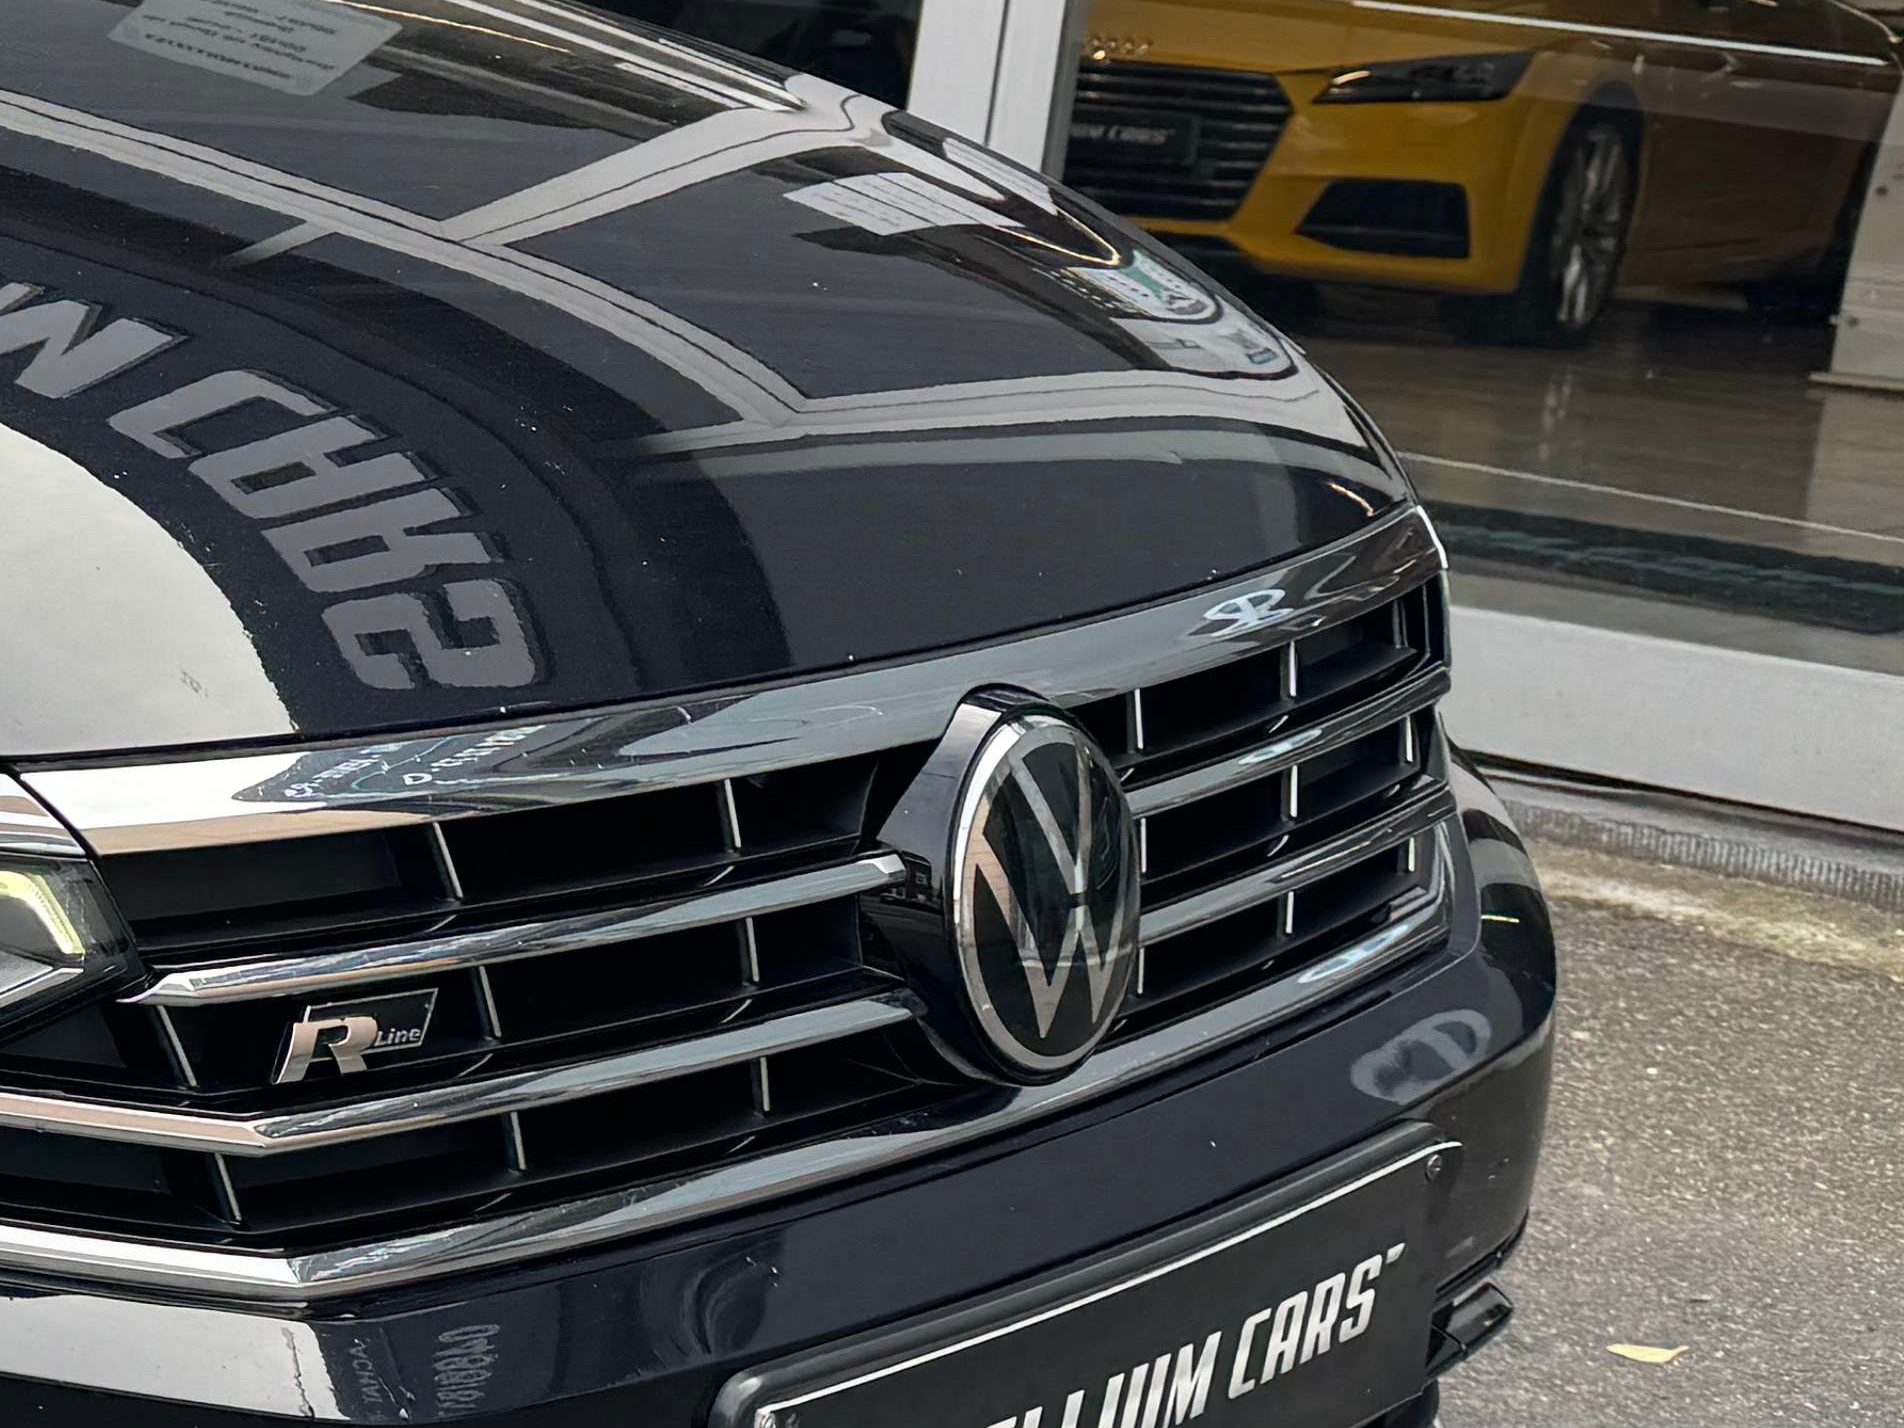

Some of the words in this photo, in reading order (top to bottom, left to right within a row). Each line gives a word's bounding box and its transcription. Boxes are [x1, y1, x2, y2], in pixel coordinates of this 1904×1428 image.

[277, 1016, 378, 1084] R
[374, 1028, 421, 1047] Line
[1227, 1254, 1384, 1401] CARS
